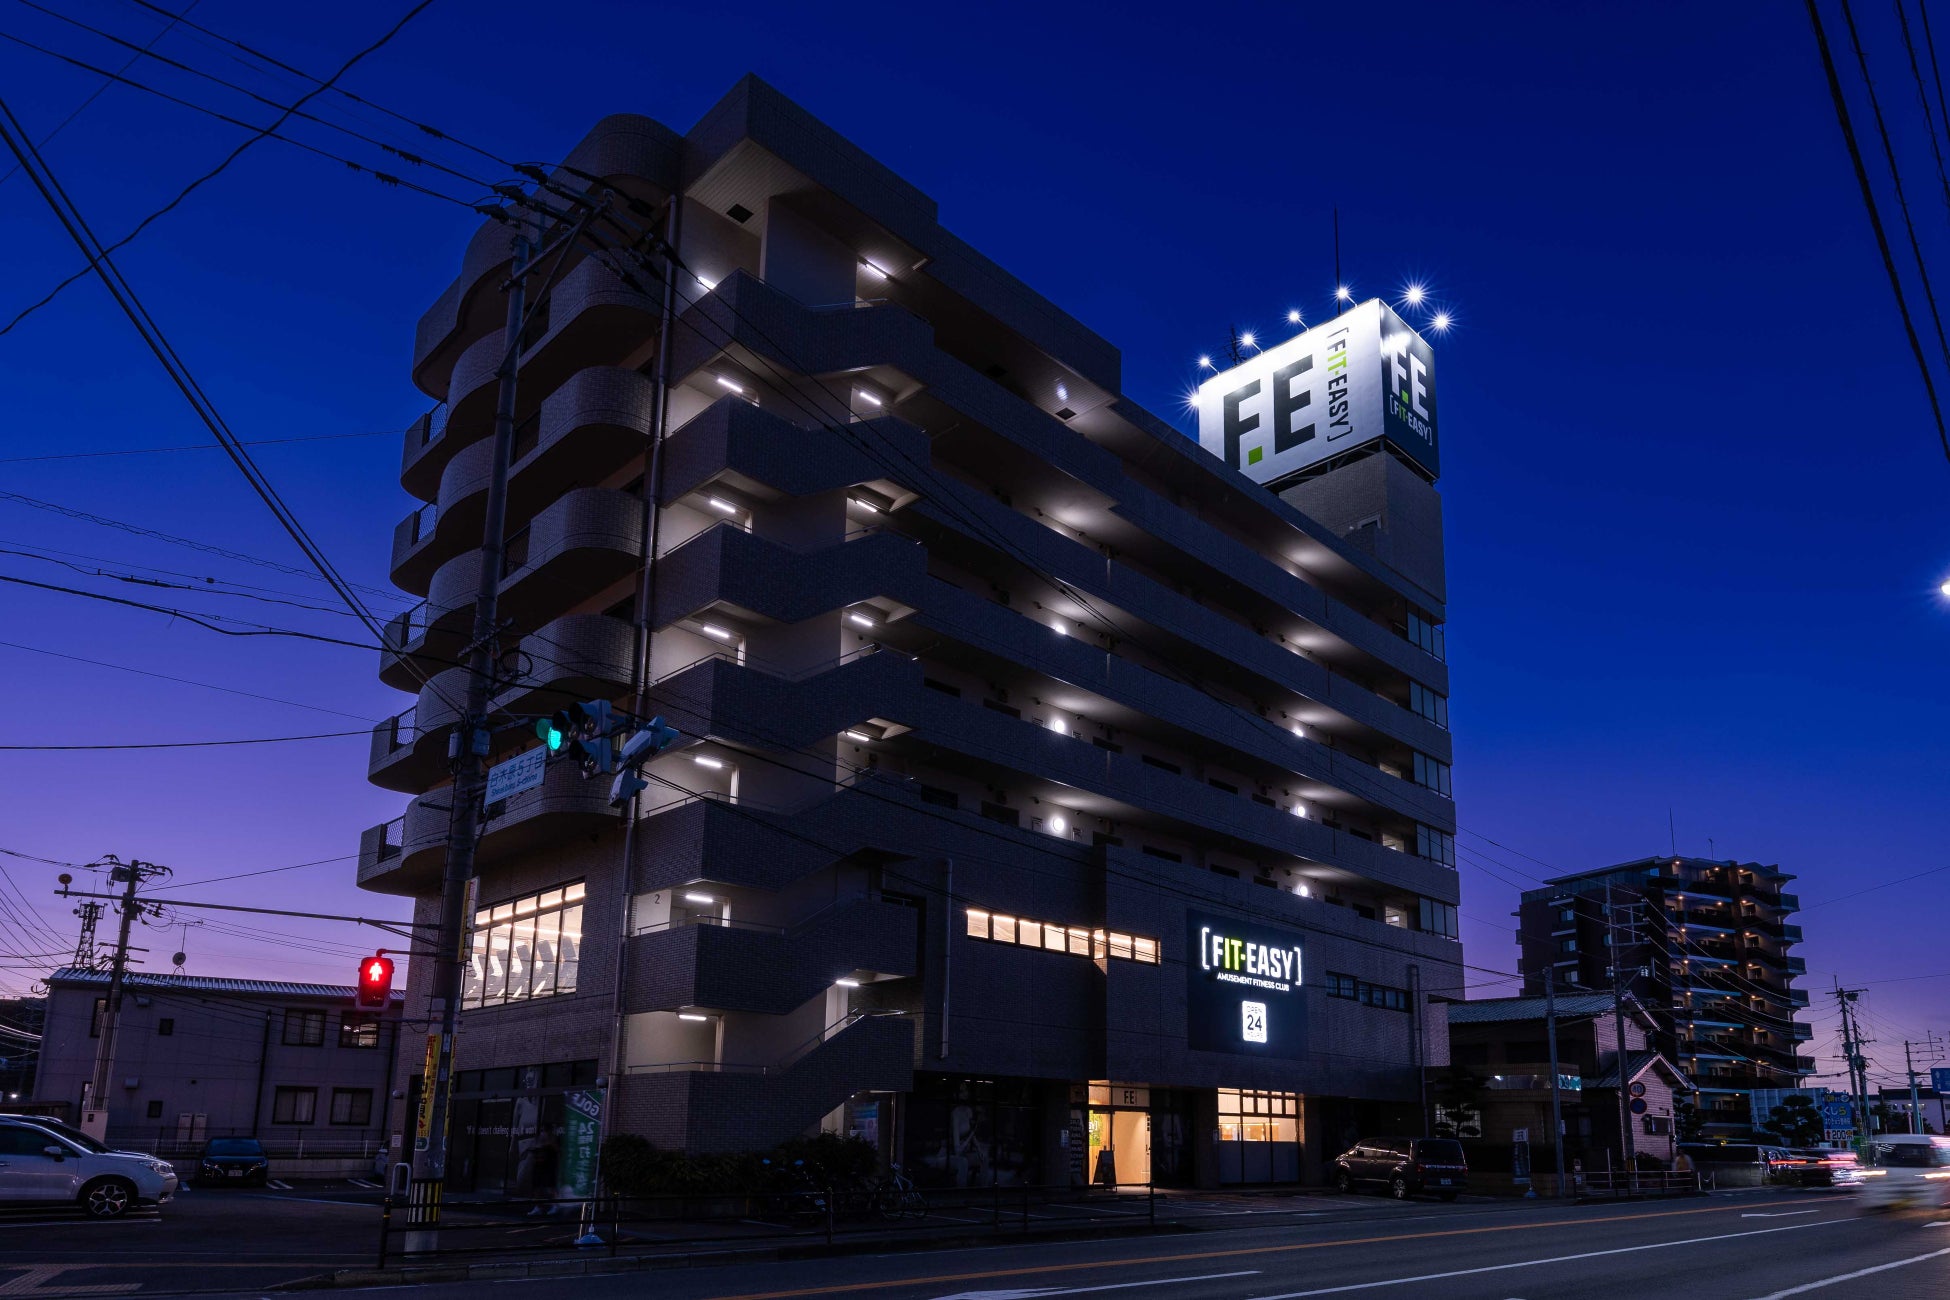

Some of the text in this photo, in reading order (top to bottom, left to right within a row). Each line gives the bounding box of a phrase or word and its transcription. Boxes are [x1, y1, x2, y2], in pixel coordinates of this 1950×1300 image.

[1217, 972, 1290, 992] AMUSEMENT FITNESS CLUB
[1246, 1013, 1263, 1032] 24
